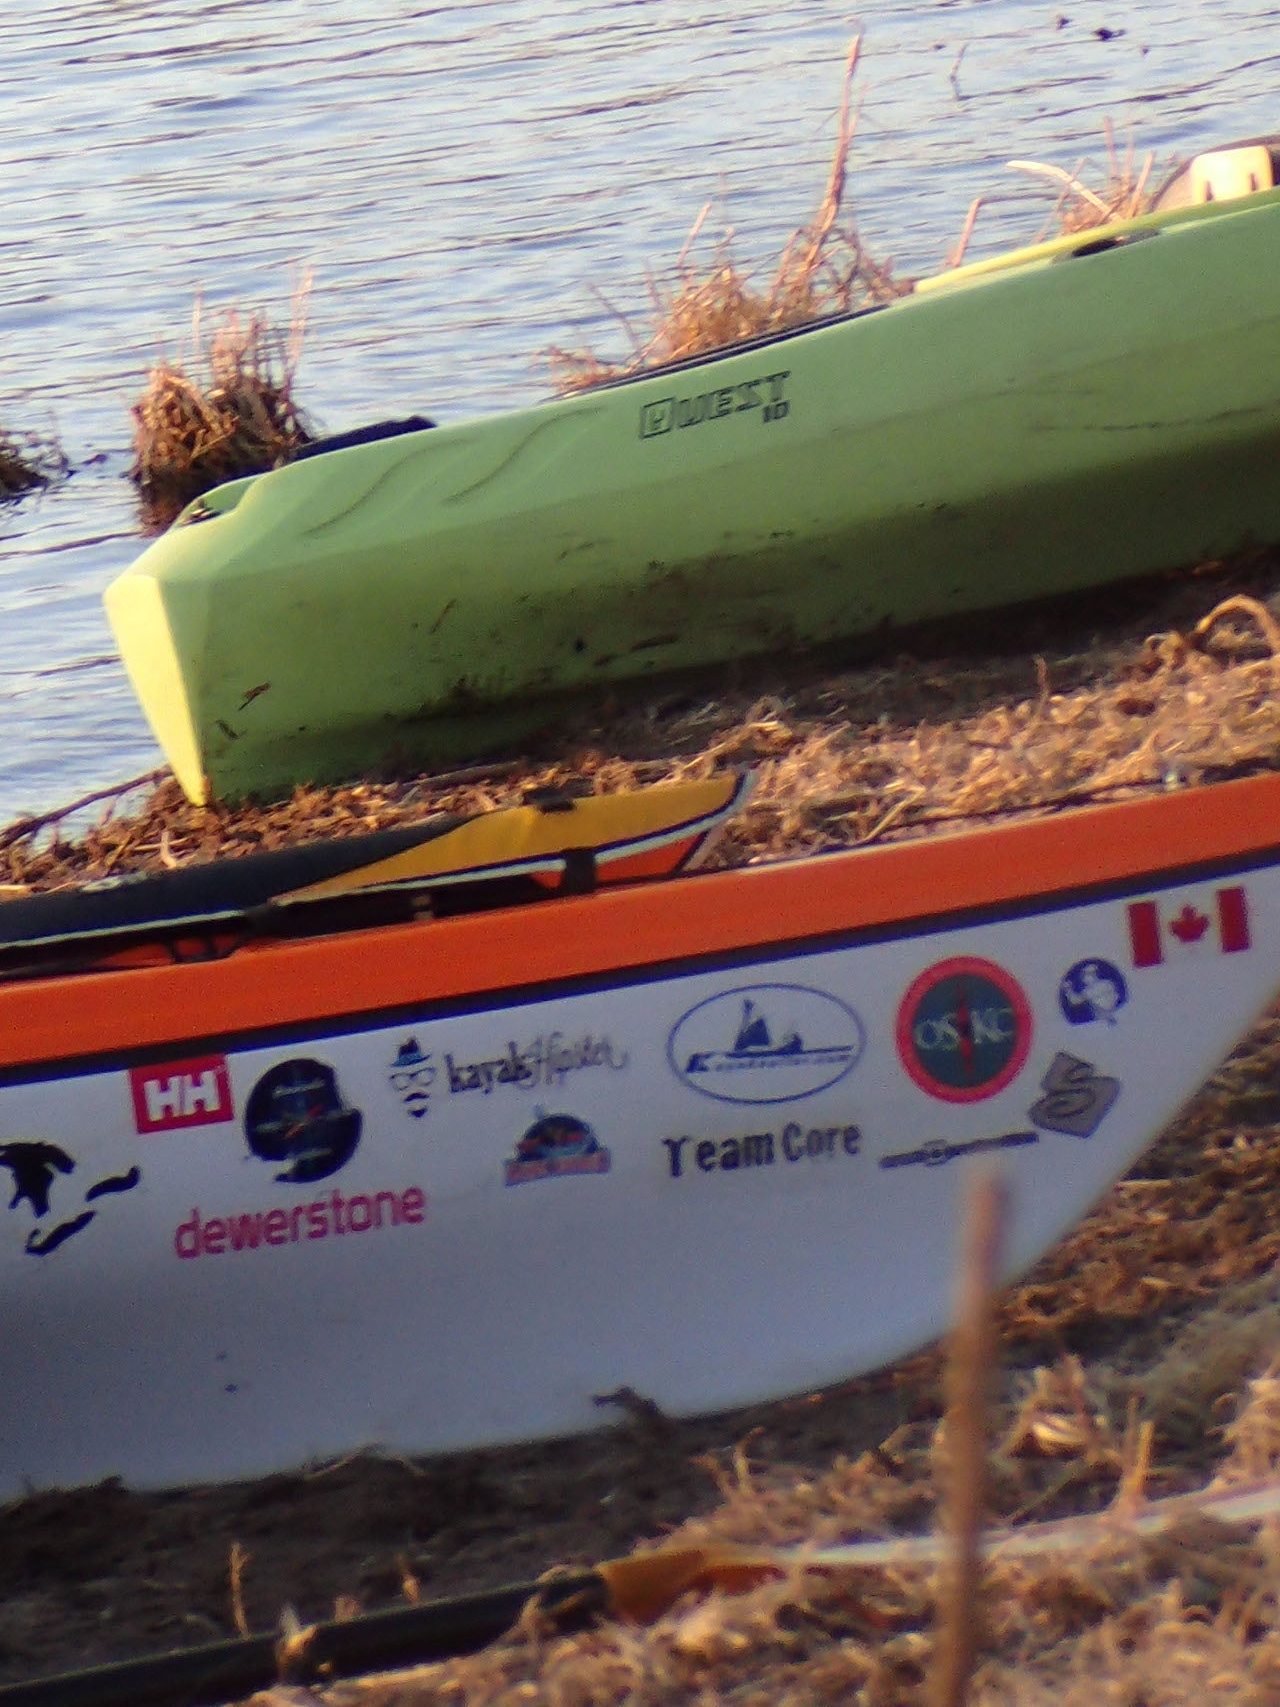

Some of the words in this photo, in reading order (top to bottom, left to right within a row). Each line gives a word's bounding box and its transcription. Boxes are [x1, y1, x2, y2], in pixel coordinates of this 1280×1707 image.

[639, 370, 792, 440] QUEST
[143, 1069, 220, 1123] HH
[662, 1133, 775, 1178] Team
[782, 1121, 863, 1163] Core
[174, 1186, 425, 1260] dewerstone
